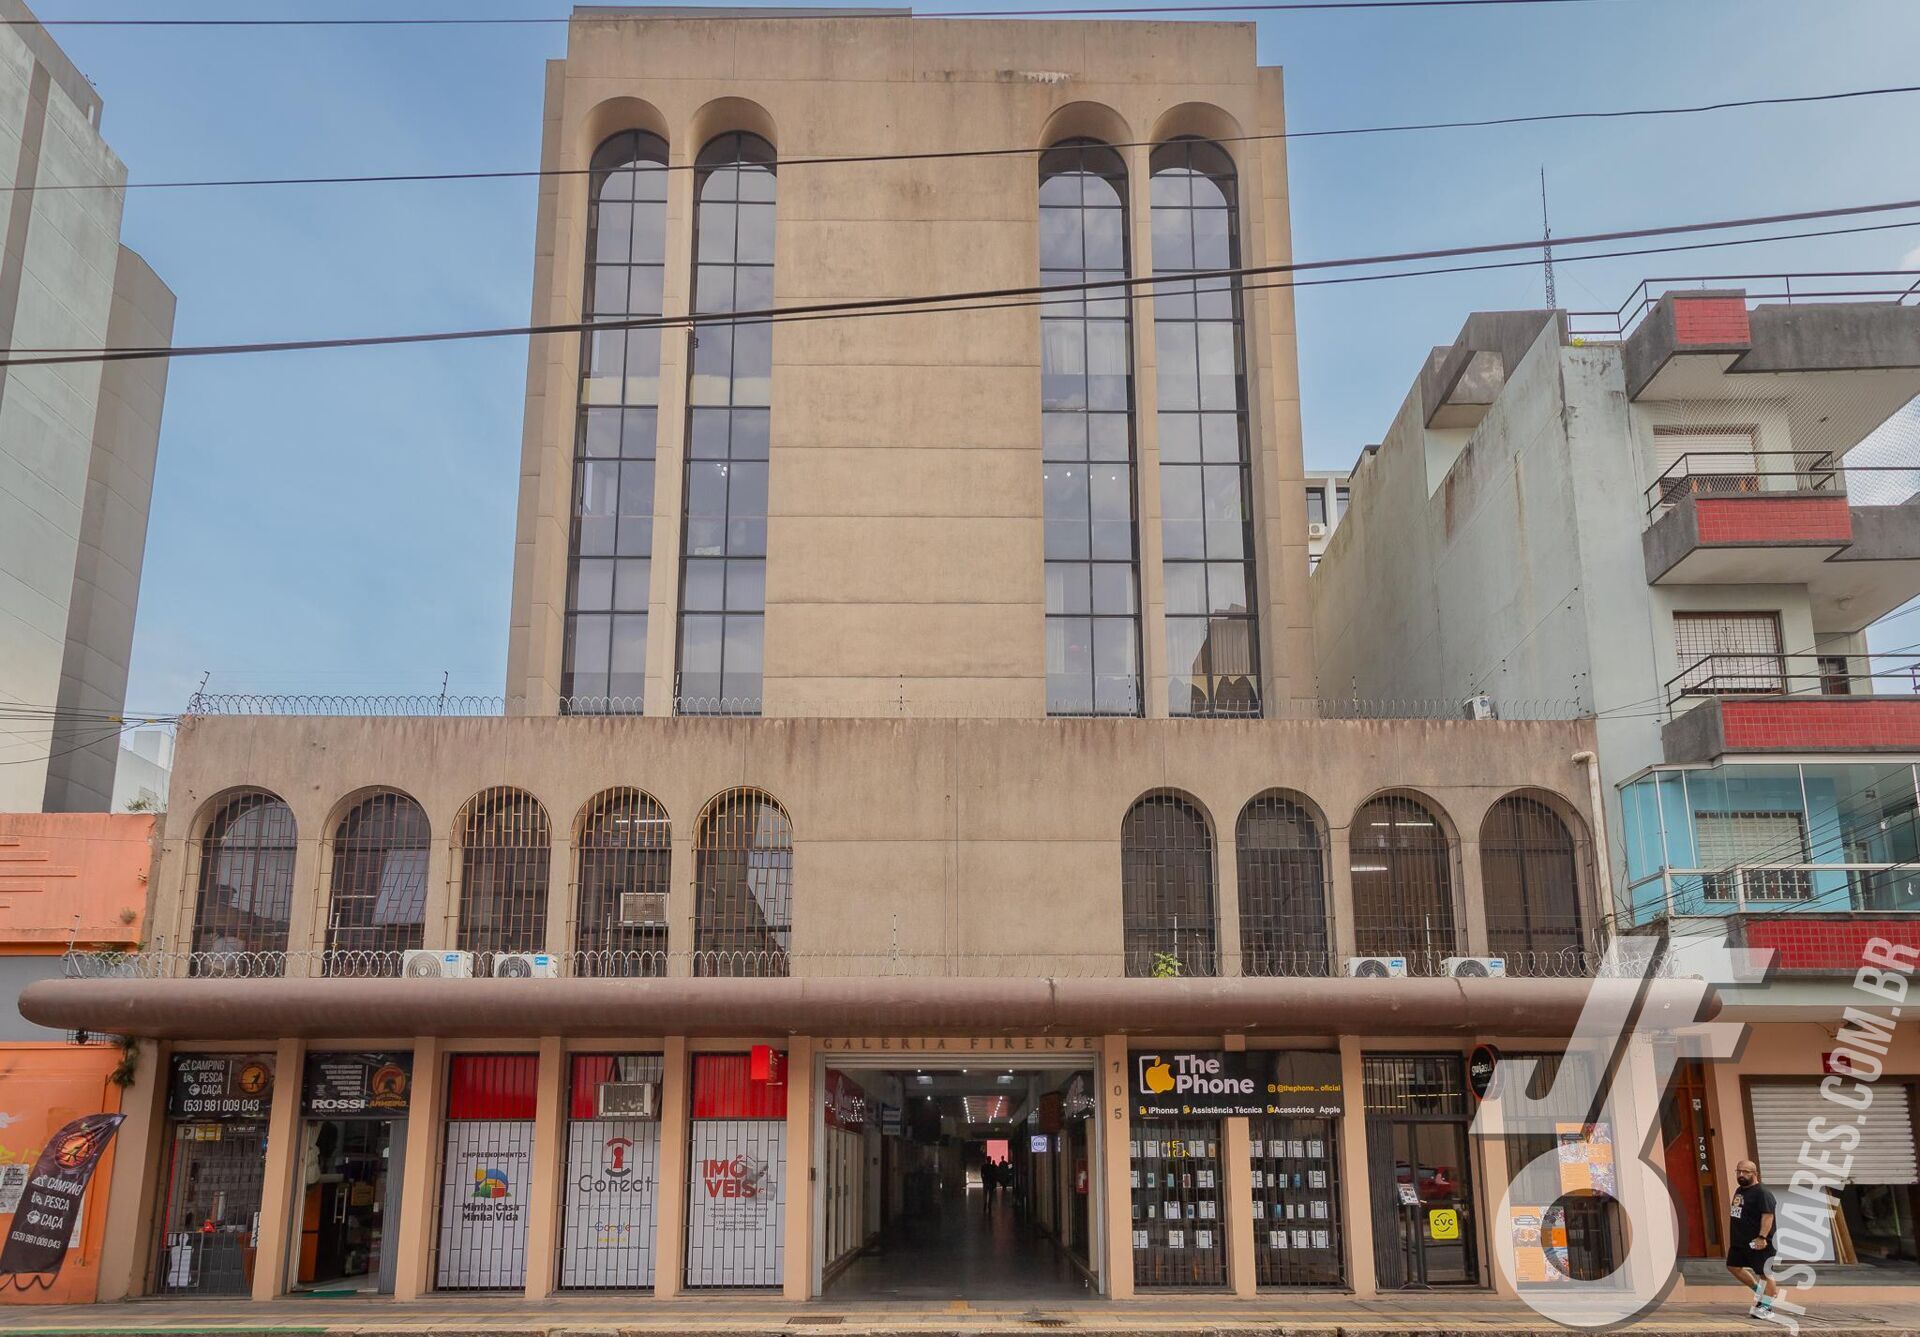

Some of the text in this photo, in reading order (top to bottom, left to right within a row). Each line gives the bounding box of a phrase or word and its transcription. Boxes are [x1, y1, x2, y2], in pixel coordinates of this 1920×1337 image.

[823, 1038, 1093, 1049] GALERIA FIRENZE
[191, 1060, 225, 1071] CAMPING
[1174, 1054, 1221, 1074] The
[198, 1072, 223, 1083] PESCA
[201, 1084, 222, 1096] CAÇA
[1112, 1061, 1122, 1120] 705
[1176, 1075, 1255, 1094] Phone
[183, 1099, 260, 1112] (53) 981 009 043
[311, 1099, 365, 1109] ROSSI
[1148, 1106, 1178, 1114] iPhones
[1192, 1106, 1262, 1114] Assistência Técnica
[1274, 1106, 1341, 1116] Acessórios Apple
[703, 1154, 747, 1178] IMÓ
[47, 1177, 83, 1196] CAMPING
[578, 1174, 653, 1192] Conect
[705, 1179, 757, 1198] VEIS
[44, 1196, 70, 1211] PESCA
[463, 1203, 519, 1211] Minha Casa
[40, 1214, 64, 1230] CAÇA
[463, 1212, 519, 1221] Minha Vida
[1433, 1218, 1454, 1226] CVC
[11, 1231, 62, 1249] (53) 981 009 043
